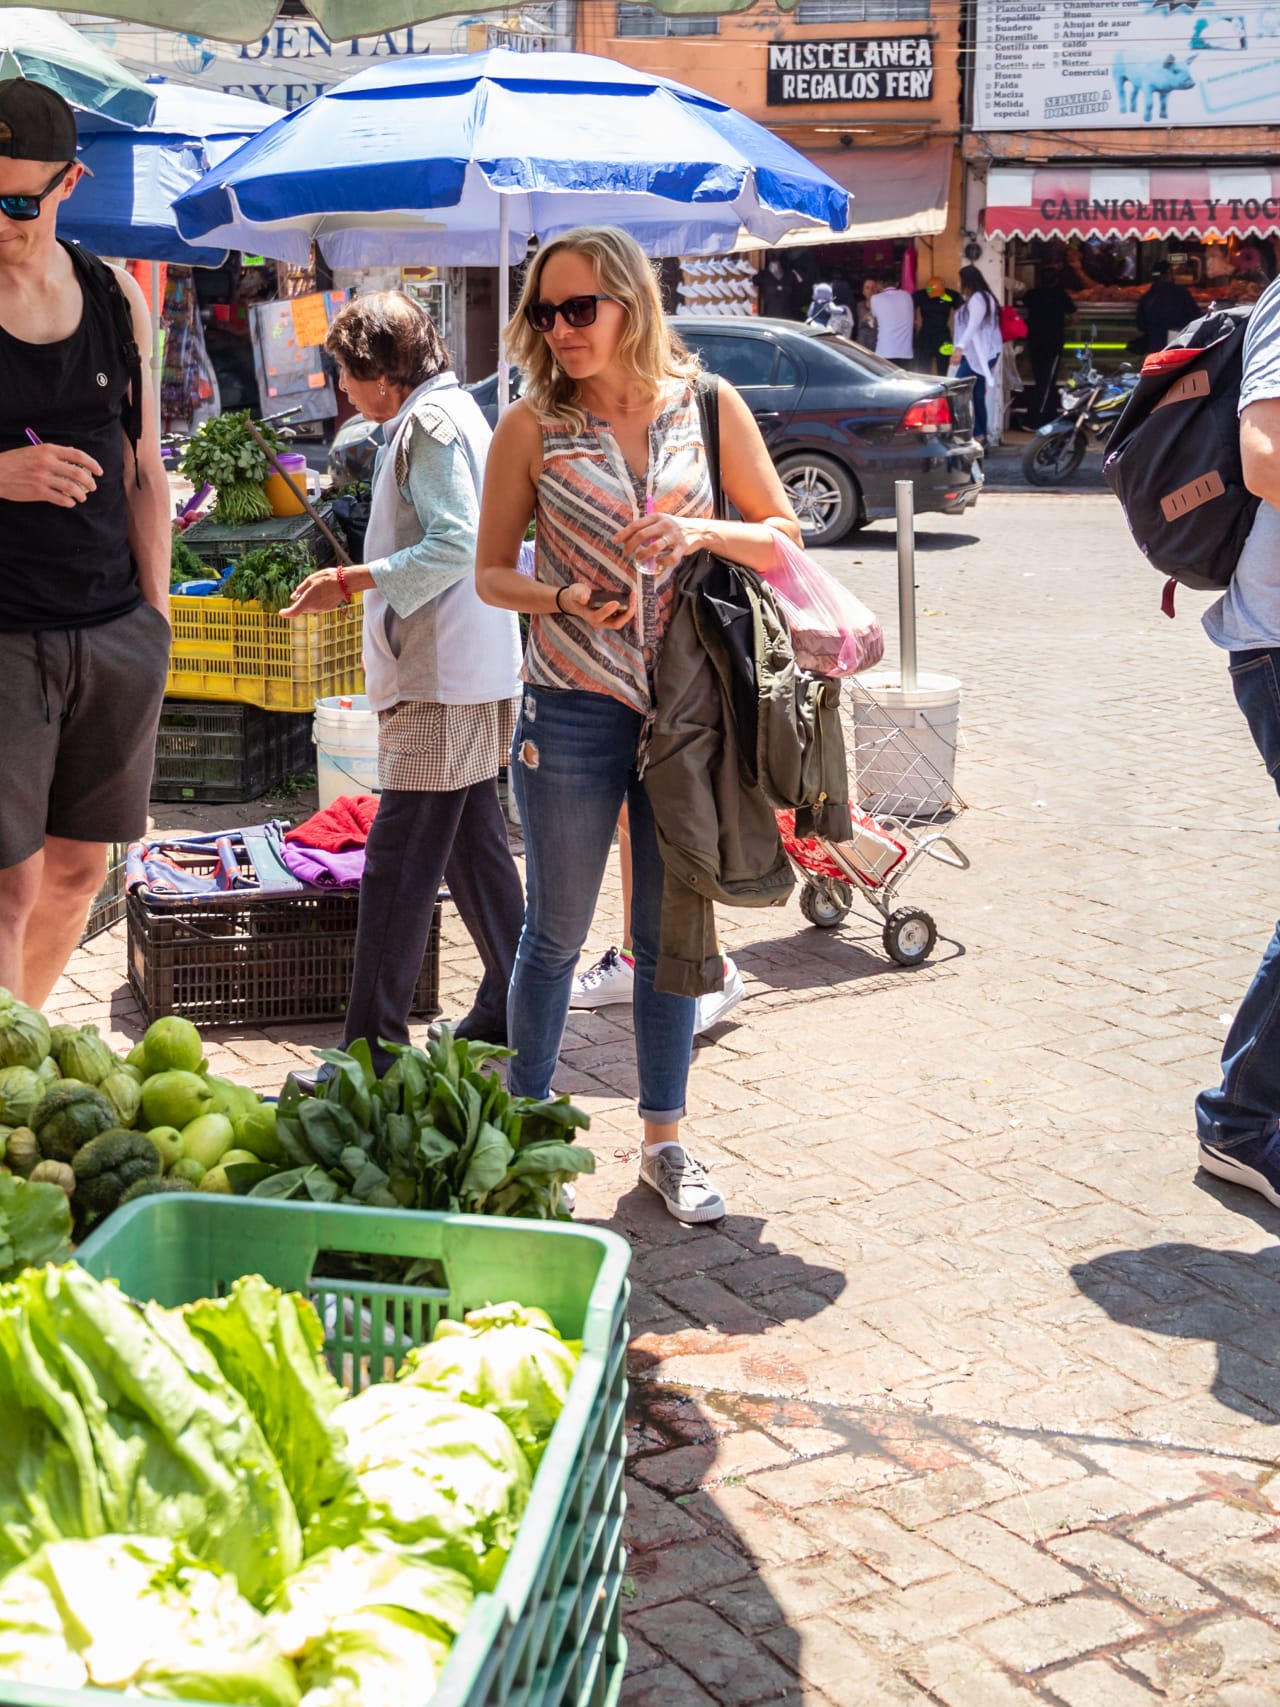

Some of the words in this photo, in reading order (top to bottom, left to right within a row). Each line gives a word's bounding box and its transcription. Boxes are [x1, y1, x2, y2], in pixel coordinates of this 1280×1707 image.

[996, 4, 1046, 13] Planchuela
[995, 24, 1032, 32] Suadero
[1063, 21, 1095, 29] Ahujas
[1098, 20, 1108, 28] de
[1063, 31, 1095, 39] Ahujas
[995, 43, 1029, 51] Costilla
[770, 39, 933, 70] MISCELANEA
[994, 71, 1023, 80] Hueso
[1062, 68, 1109, 77] Comercial
[783, 72, 880, 99] REGALOS
[885, 70, 933, 98] FERY
[994, 81, 1019, 89] Falda
[993, 90, 1024, 98] Maciza
[1045, 91, 1101, 108] SERVICIO
[1102, 89, 1112, 101] A
[993, 100, 1024, 108] Molida
[993, 109, 1030, 119] especial
[1044, 101, 1109, 119] DOMICILIO
[1041, 198, 1198, 221] CARNICERIA
[1205, 198, 1220, 220] Y
